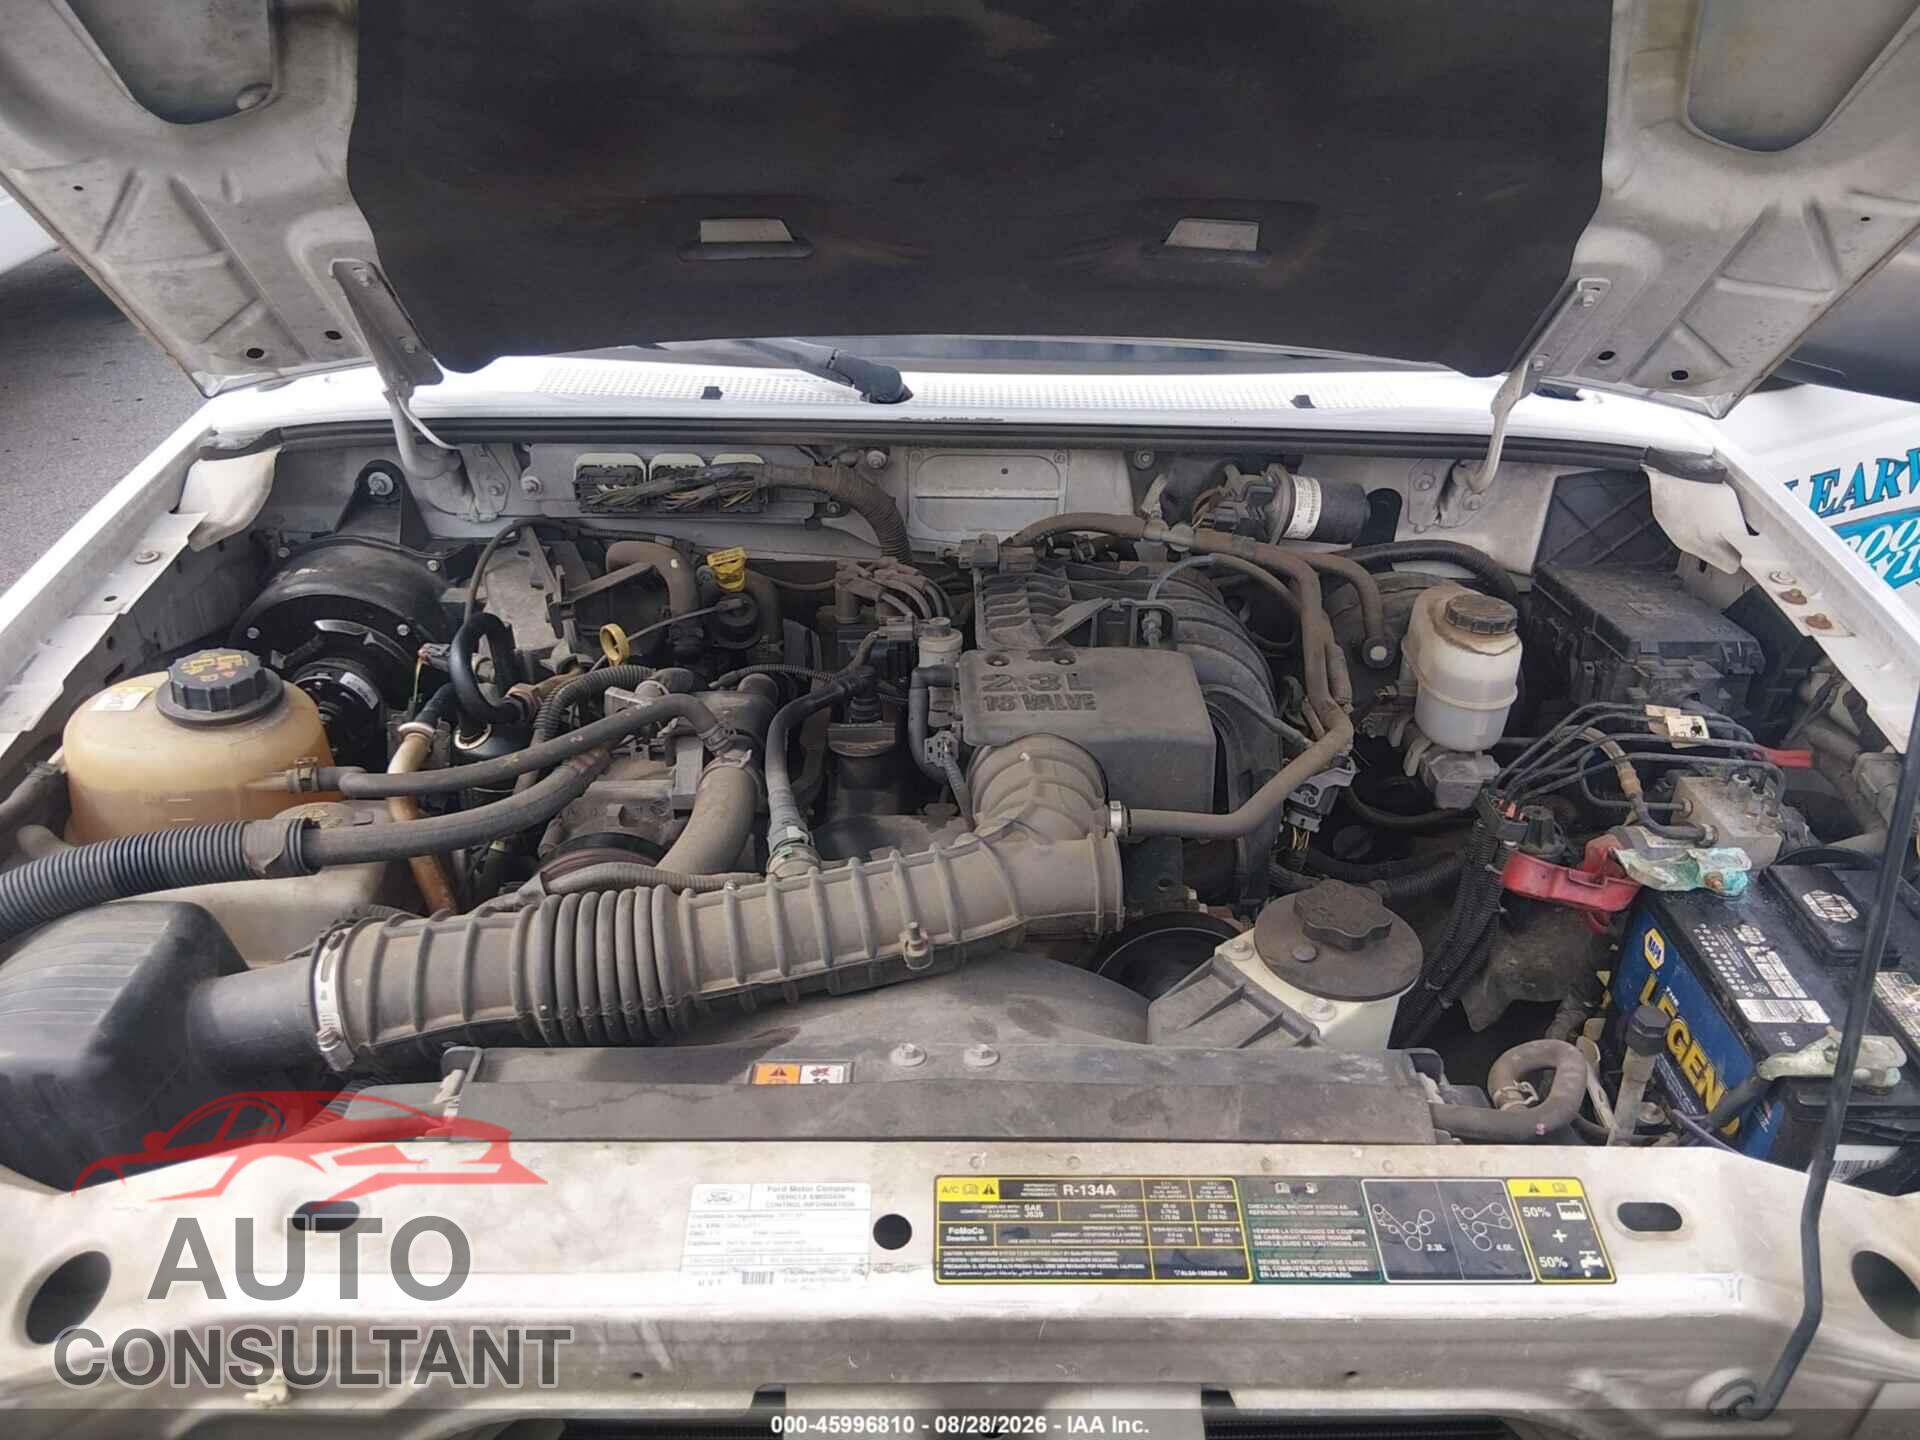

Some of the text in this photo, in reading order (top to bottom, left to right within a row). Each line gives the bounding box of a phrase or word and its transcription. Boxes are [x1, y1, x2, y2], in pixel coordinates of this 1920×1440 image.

[981, 673, 1093, 692] 2.3L
[1022, 693, 1097, 711] VALVE
[942, 1184, 960, 1194] A/C
[1062, 1183, 1116, 1196] R-134A
[1522, 1206, 1551, 1218] 50%
[948, 1226, 984, 1234] FoMoCo
[1538, 1256, 1568, 1268] 50%
